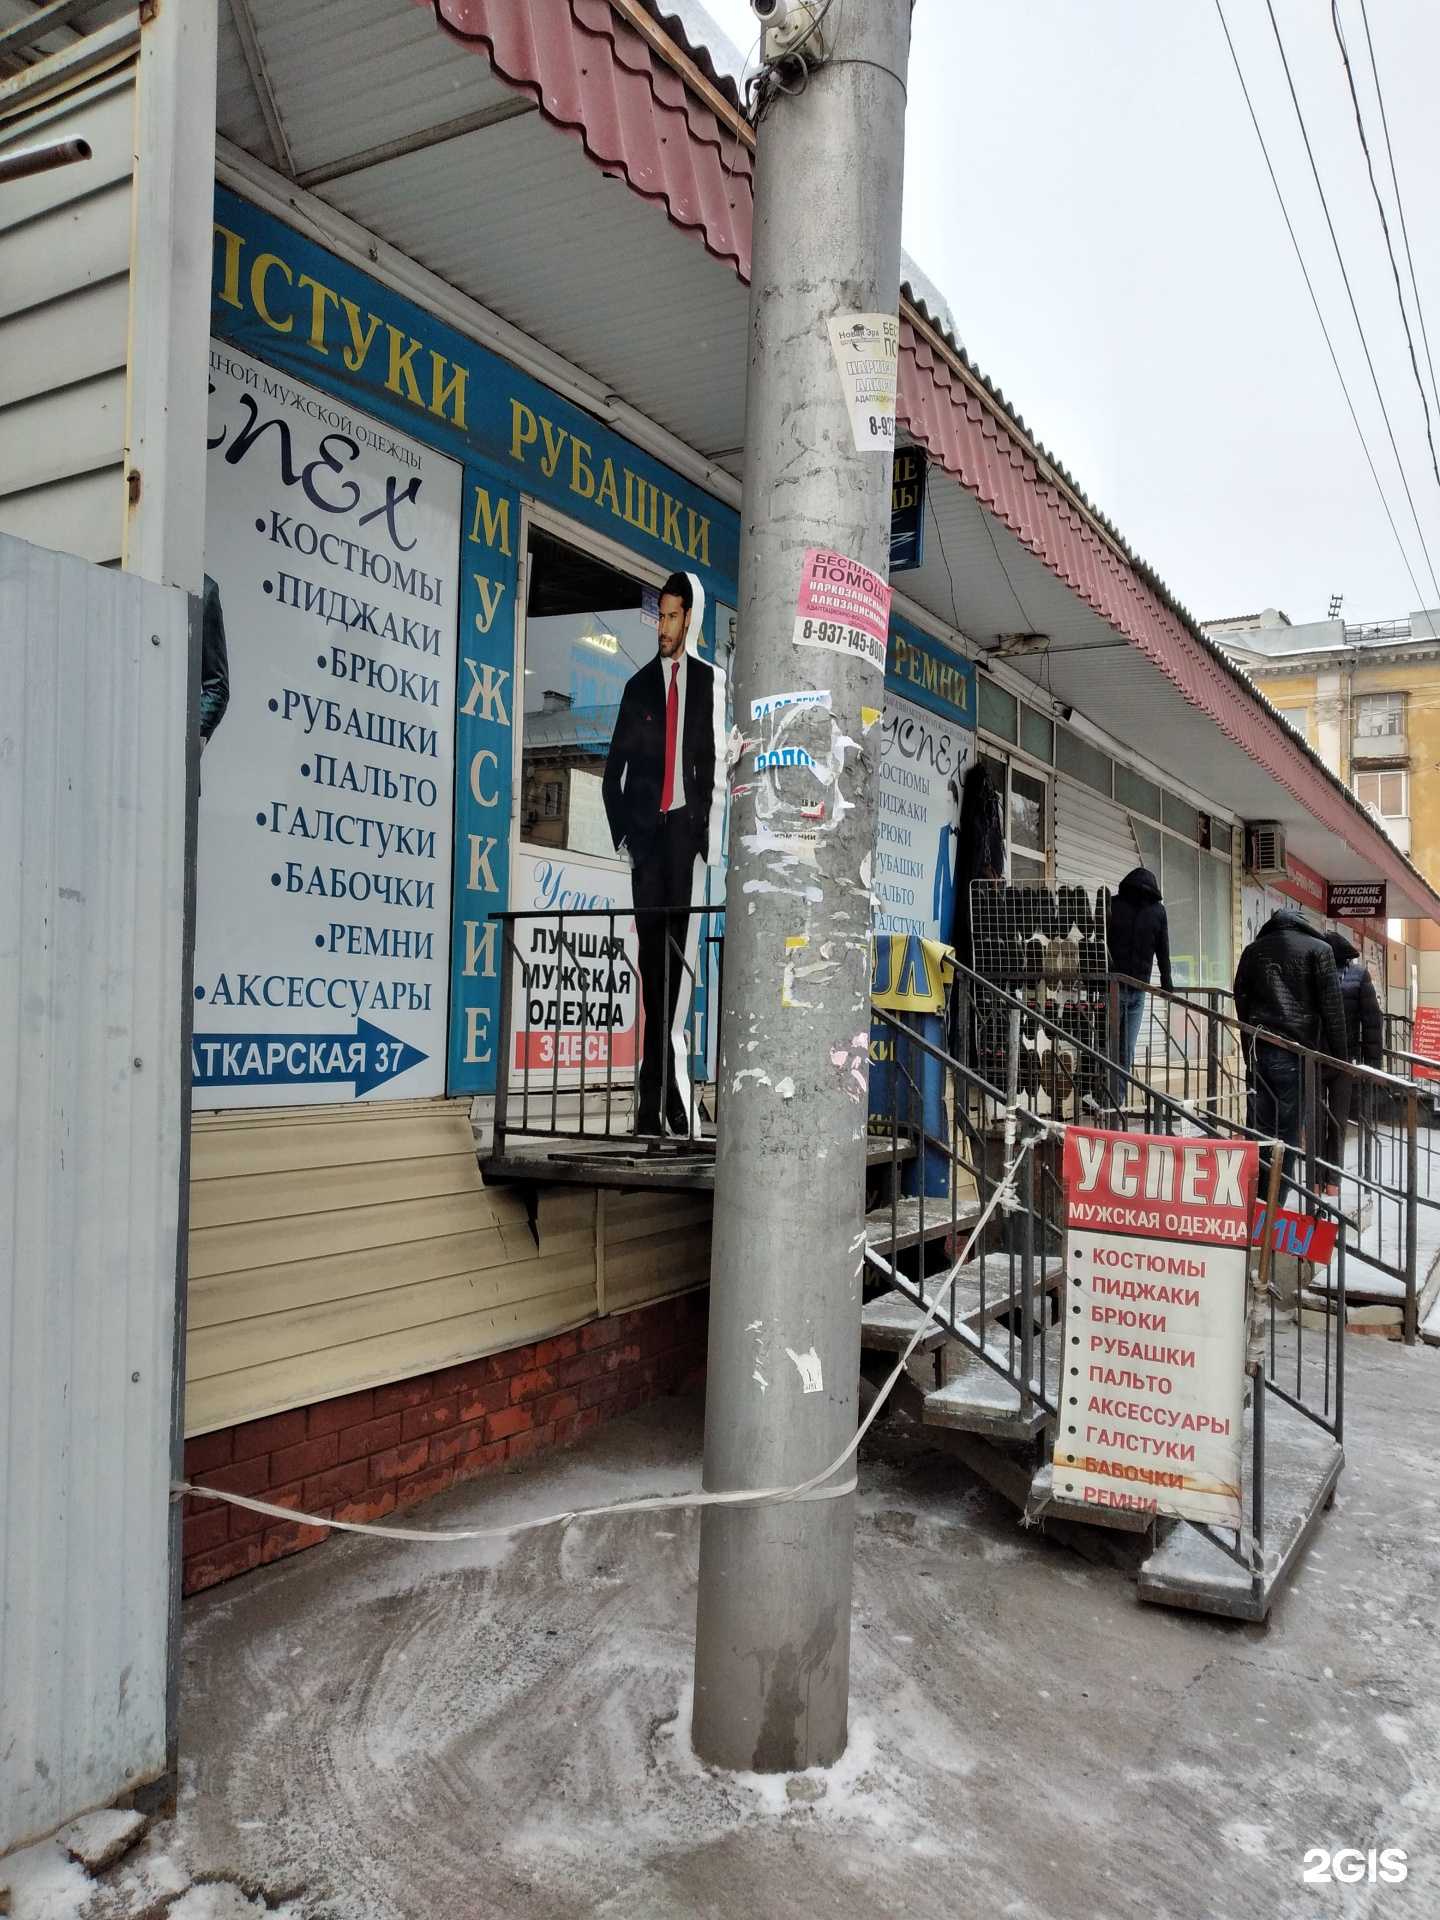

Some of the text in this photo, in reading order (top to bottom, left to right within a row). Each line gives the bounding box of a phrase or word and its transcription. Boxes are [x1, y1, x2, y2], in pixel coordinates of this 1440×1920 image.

[264, 377, 352, 436] МУЖСКОЙ
[355, 424, 422, 471] ОДЕЖДЫ
[508, 397, 712, 568] РУБАШКИ
[268, 509, 442, 606] КОСТЮМЫ
[276, 571, 442, 658] ПИДЖАКИ
[330, 646, 440, 708] БРЮКИ
[893, 635, 968, 711] РЕМНИ
[282, 687, 439, 758] РУБАШКИ
[313, 751, 438, 807] ПАЛЬТО
[463, 484, 512, 1063] МУЖСКИЕ
[879, 761, 930, 796] ОСТЮМЫ
[268, 801, 437, 860] ГАЛСТУКИ
[877, 821, 912, 848] РЮКИ
[876, 851, 924, 880] УБАШКИ
[285, 861, 436, 911] БАБОЧКИ
[1330, 895, 1382, 905] КОСТЮМЫ
[1333, 886, 1381, 895] МУЖСКИЕ
[328, 923, 434, 961] РЕМНИ
[210, 973, 432, 1017] АКСЕССУАРЫ
[522, 962, 631, 994] МУЖСКАЯ
[529, 999, 625, 1031] ОДЕЖДА
[374, 1042, 404, 1073] 37
[539, 1034, 610, 1067] ЗДЕСЬ
[1074, 1134, 1249, 1209] УСПЕХ
[1068, 1202, 1249, 1242] МУЖСКАЯ ОДЕЖДА
[1091, 1246, 1207, 1279] КОСТЮМЫ
[1091, 1275, 1200, 1308] ПИДЖАКИ
[1090, 1305, 1167, 1333] БРЮКИ
[1089, 1335, 1196, 1368] РУБАШКИ
[1088, 1364, 1173, 1395] ПАЛЬТО
[1087, 1395, 1231, 1437] АКСЕССУАРЫ
[1085, 1424, 1196, 1462] ГАЛСТУКИ
[1084, 1456, 1185, 1489] БАБОЧКИ
